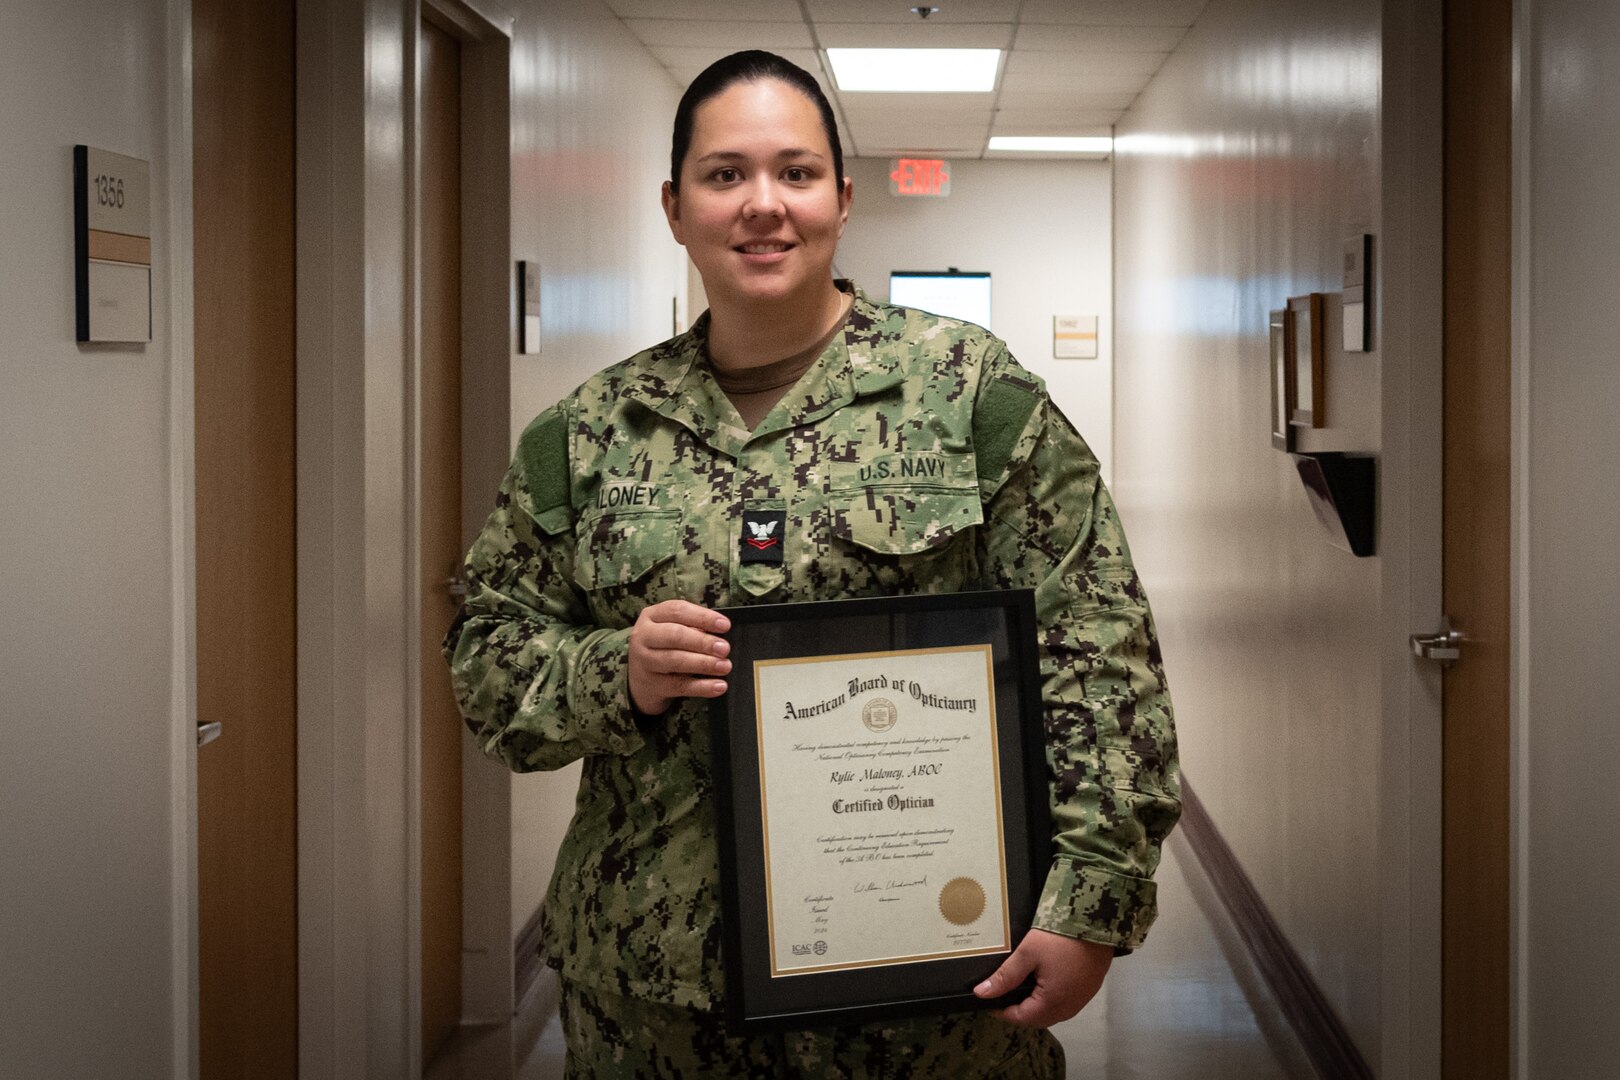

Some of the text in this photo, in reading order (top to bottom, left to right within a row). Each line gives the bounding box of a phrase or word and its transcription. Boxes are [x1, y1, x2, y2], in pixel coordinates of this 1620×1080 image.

[898, 158, 944, 194] EXIT
[95, 174, 124, 209] 1356
[860, 457, 945, 481] U.S. NAVY
[783, 693, 846, 720] American
[848, 674, 888, 699] Board
[892, 679, 905, 692] of
[909, 681, 976, 713] Opticianry
[830, 770, 855, 785] Rylie
[907, 763, 942, 778] ABOC
[832, 794, 934, 814] Certified Optician
[791, 943, 812, 952] ICAC
